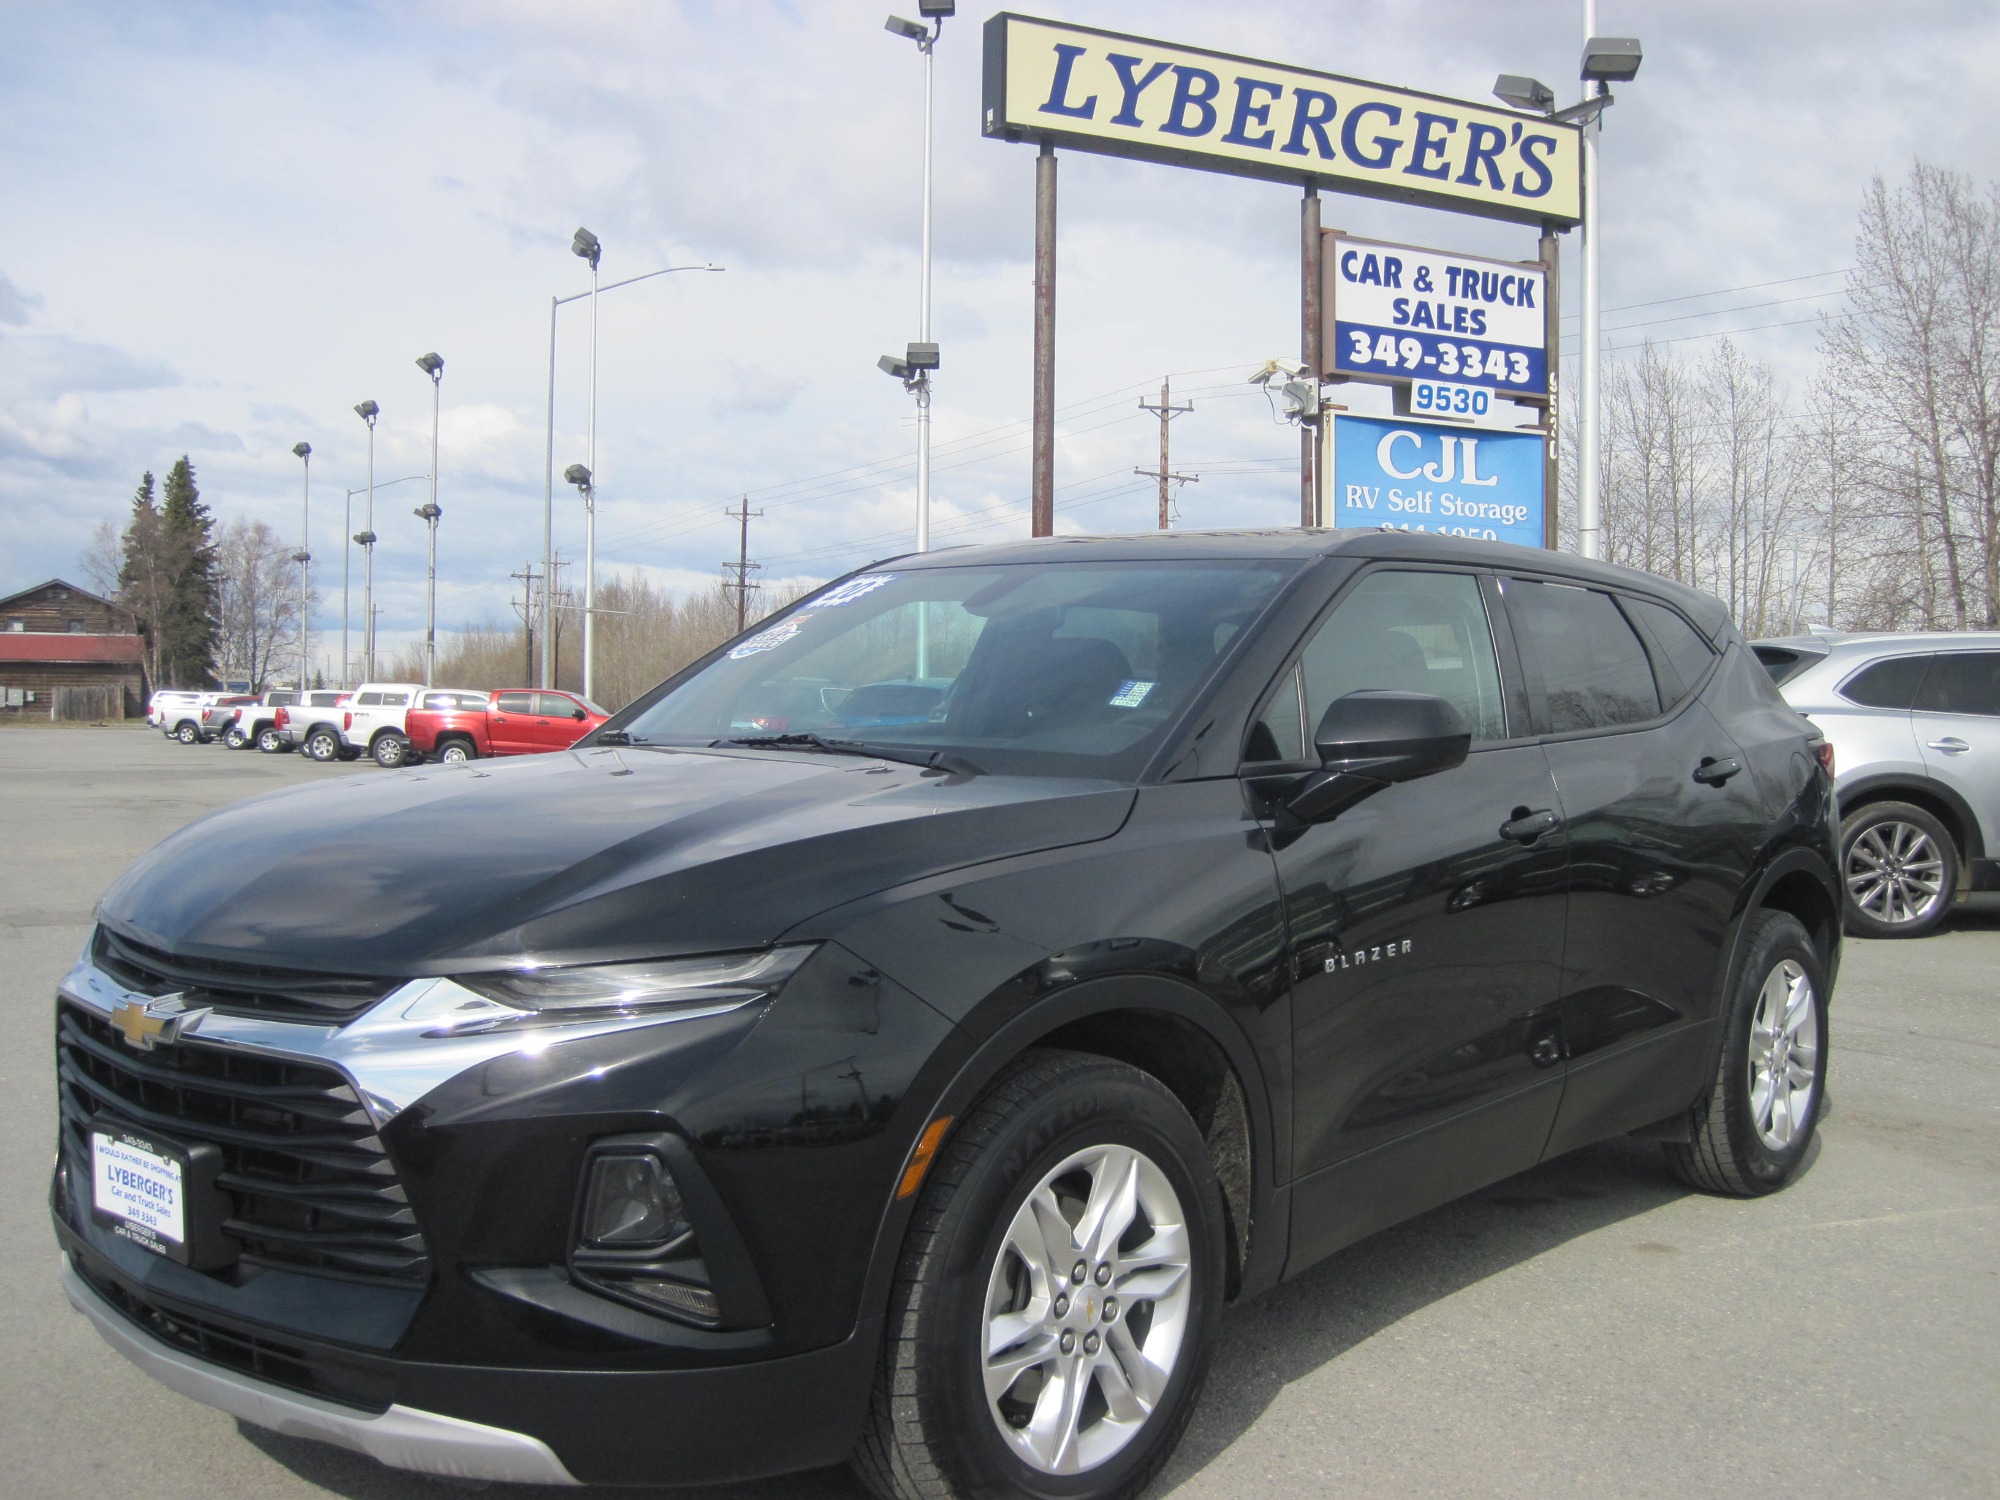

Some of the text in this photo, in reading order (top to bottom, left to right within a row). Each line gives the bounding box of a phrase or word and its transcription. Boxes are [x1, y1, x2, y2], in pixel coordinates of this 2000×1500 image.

[1038, 43, 1557, 198] LYBERGER'S
[1340, 250, 1536, 309] CAR & TRUCK
[1392, 298, 1487, 336] SALES
[1349, 331, 1530, 384] 349-3343
[1416, 384, 1489, 416] 9530
[1376, 430, 1498, 487] CJL
[1345, 485, 1528, 525] RV Self Storage
[1324, 939, 1412, 973] BLAZER
[99, 1145, 120, 1158] WOULD
[120, 1151, 142, 1167] RATHER
[143, 1160, 150, 1169] BE
[150, 1163, 174, 1180] SHOPPING
[108, 1164, 174, 1205] LYBERGER'S
[111, 1185, 171, 1218] Car and Truck Sales
[127, 1206, 157, 1226] 349 3343
[114, 1225, 126, 1237] CAR
[132, 1232, 150, 1246] TRUCK
[150, 1241, 166, 1254] SALES
